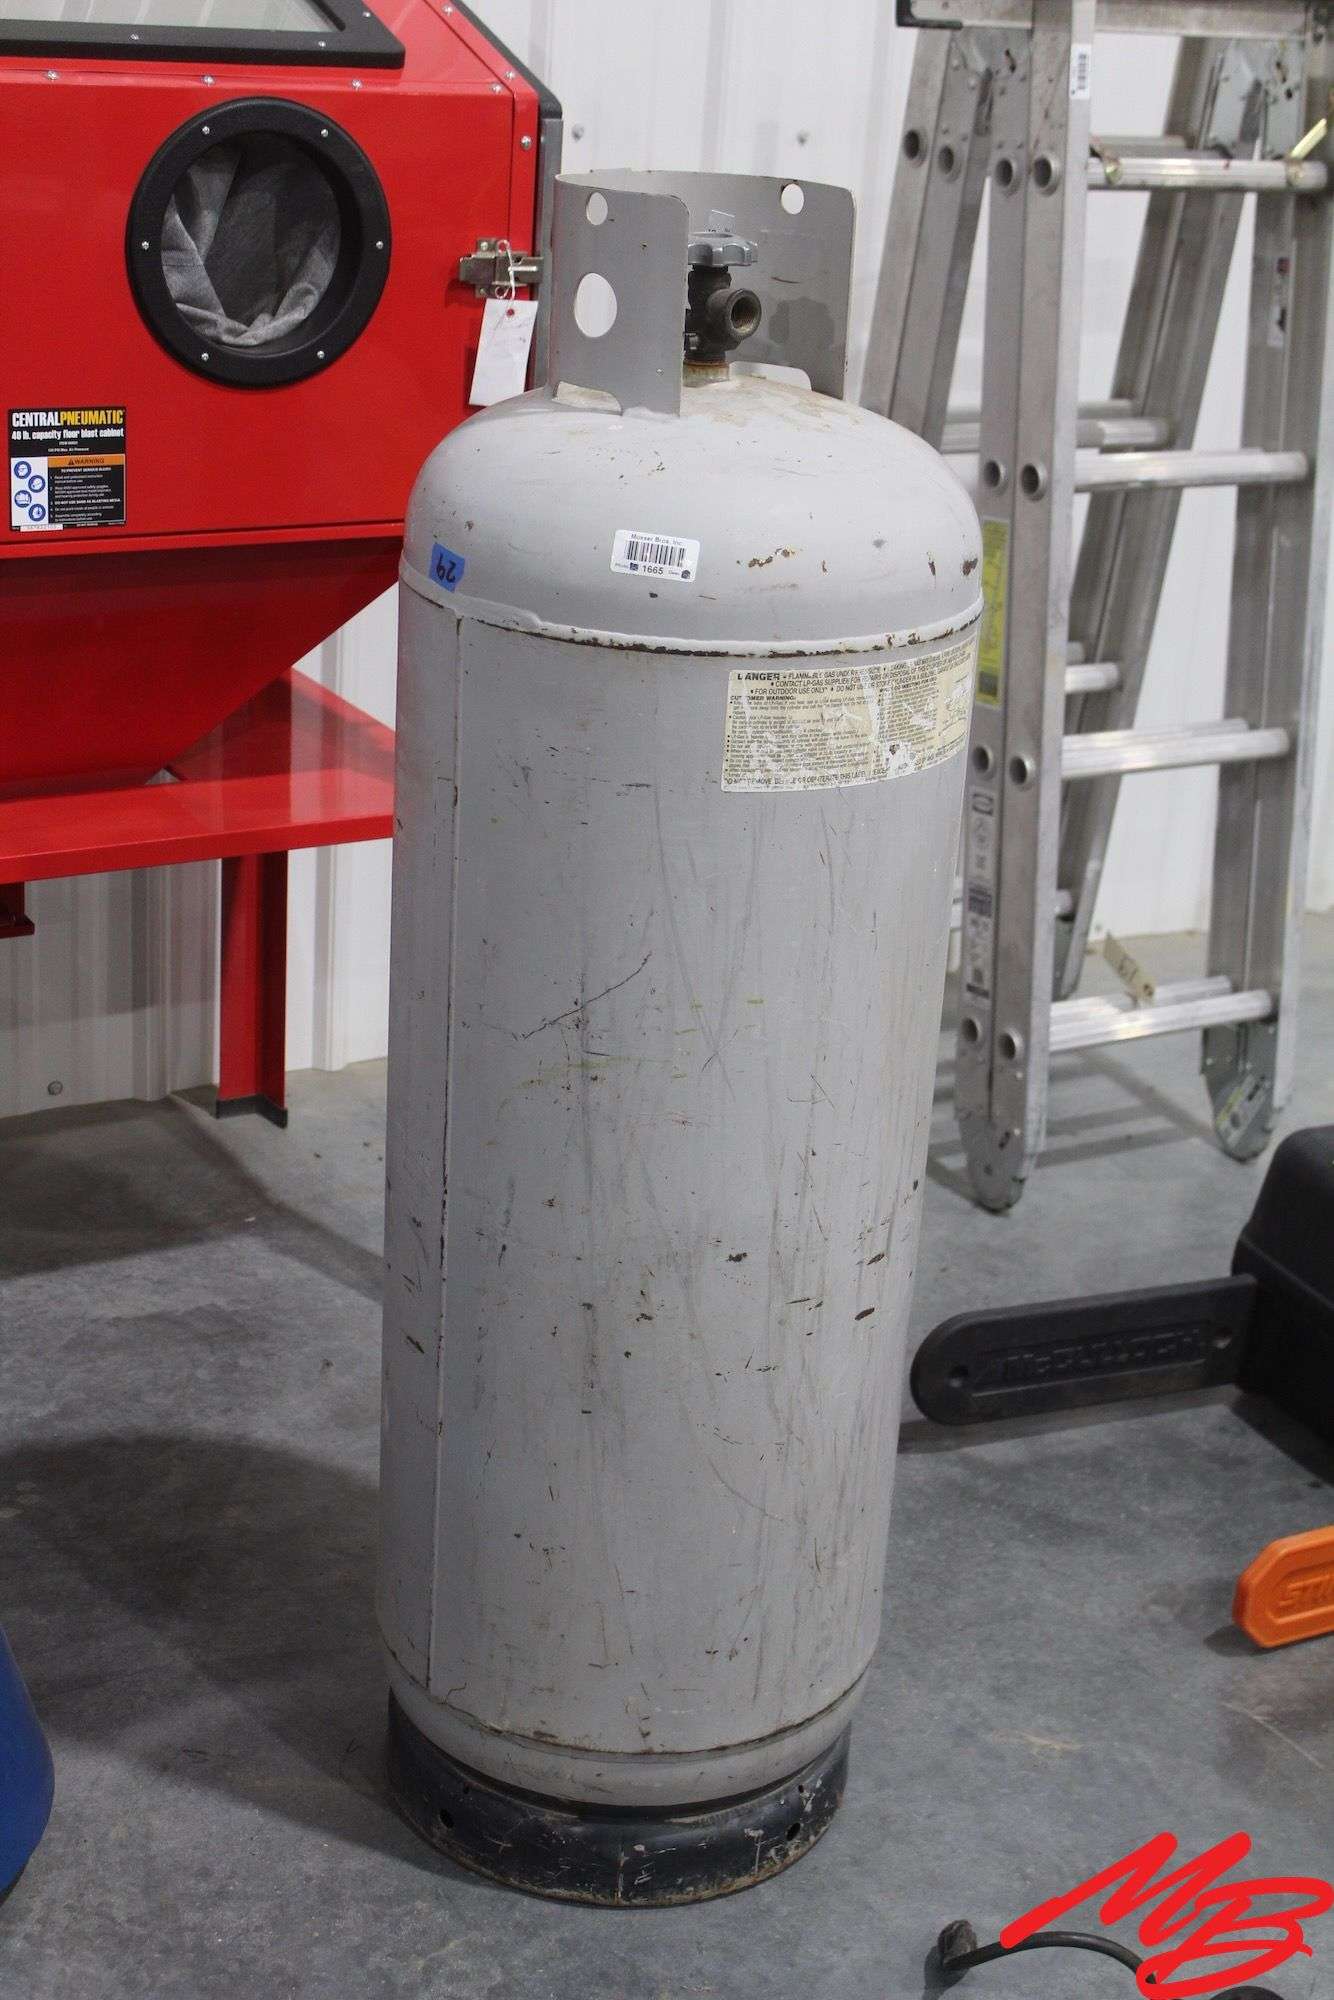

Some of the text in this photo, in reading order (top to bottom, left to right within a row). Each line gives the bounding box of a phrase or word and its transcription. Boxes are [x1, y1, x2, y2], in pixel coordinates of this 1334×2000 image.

[32, 429, 61, 440] capacity
[63, 429, 79, 438] floor
[81, 428, 98, 437] blast
[100, 427, 124, 437] cabinet
[642, 565, 664, 575] 1665
